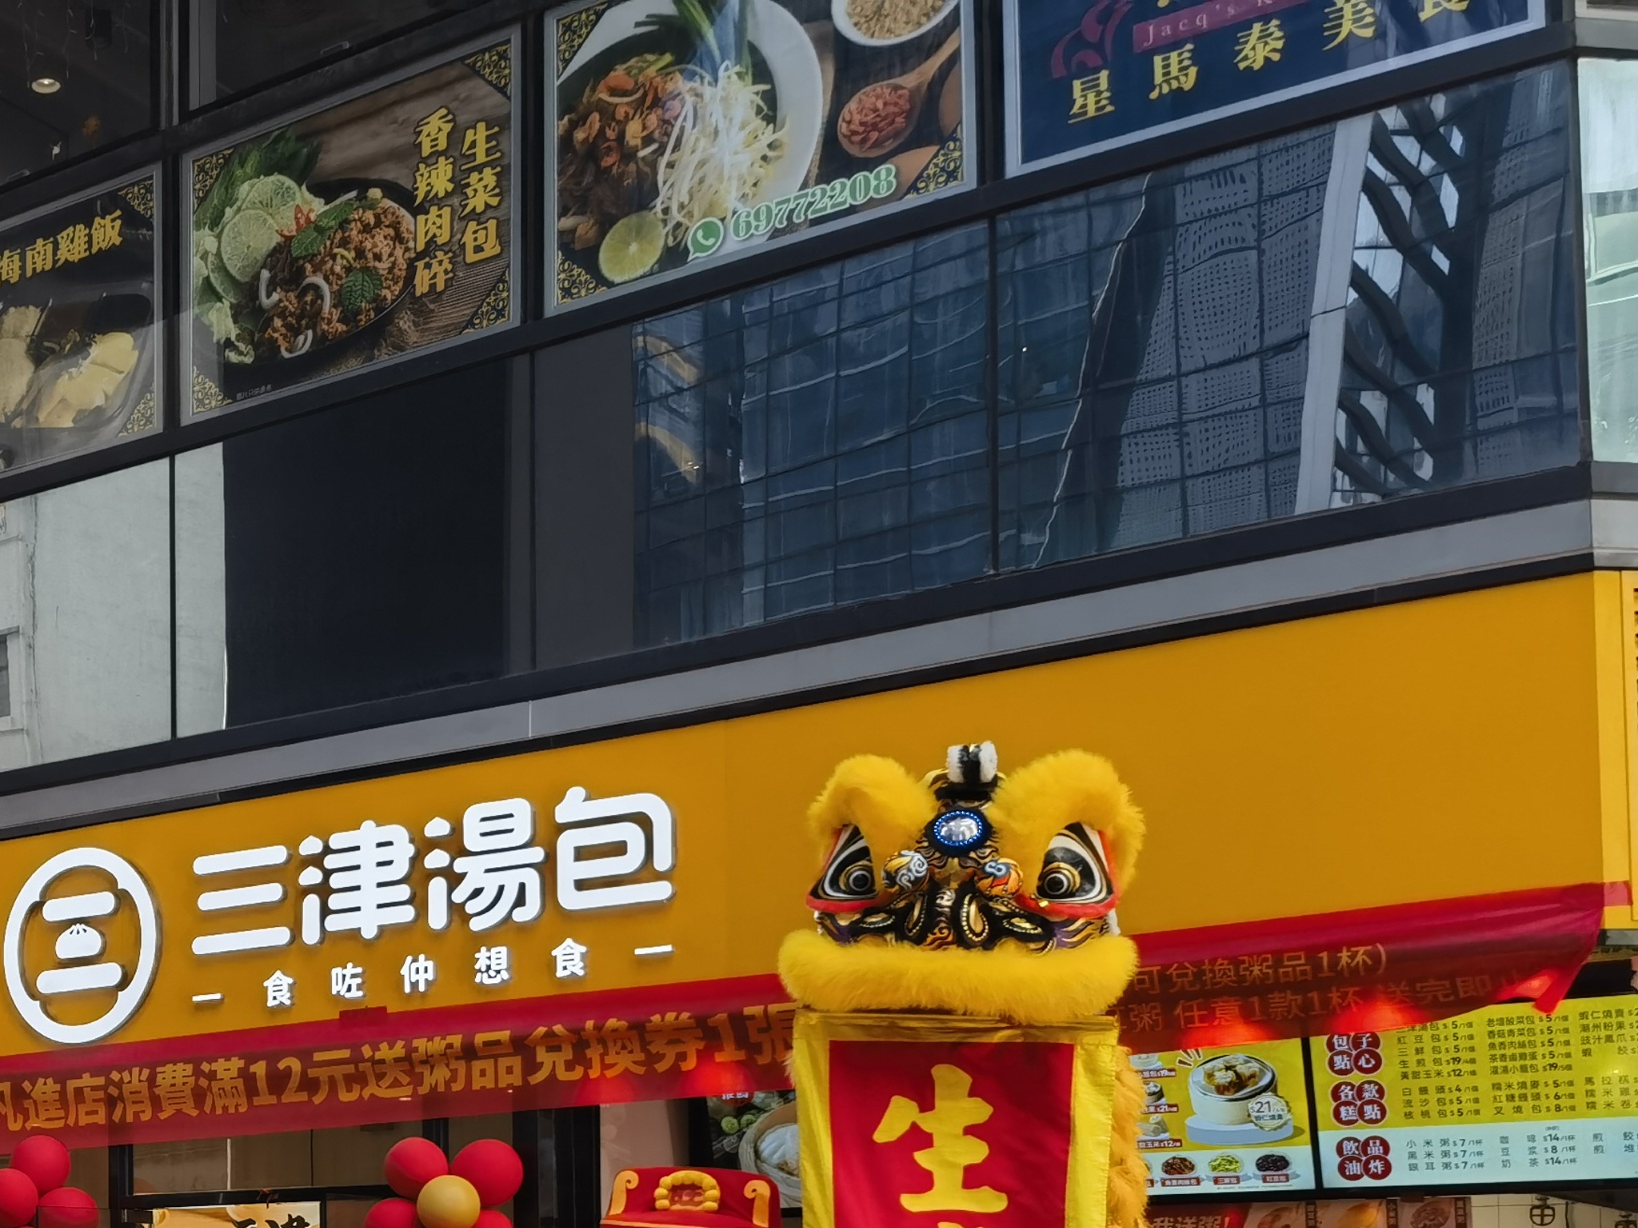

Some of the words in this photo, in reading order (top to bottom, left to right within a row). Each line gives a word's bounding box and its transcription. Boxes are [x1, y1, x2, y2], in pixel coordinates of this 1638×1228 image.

[412, 105, 456, 298] 香辣肉碎
[459, 120, 504, 268] 生菜包
[729, 164, 898, 243] 69772208
[192, 785, 676, 957] 三津湯包
[263, 937, 588, 1010] 食咗仲想食
[1332, 1034, 1373, 1049] 包子
[1333, 1054, 1375, 1071] 點心
[1338, 1083, 1379, 1099] 各款
[1339, 1105, 1381, 1121] 糕點
[1342, 1140, 1384, 1155] 飲品
[1344, 1160, 1385, 1175] 油炸
